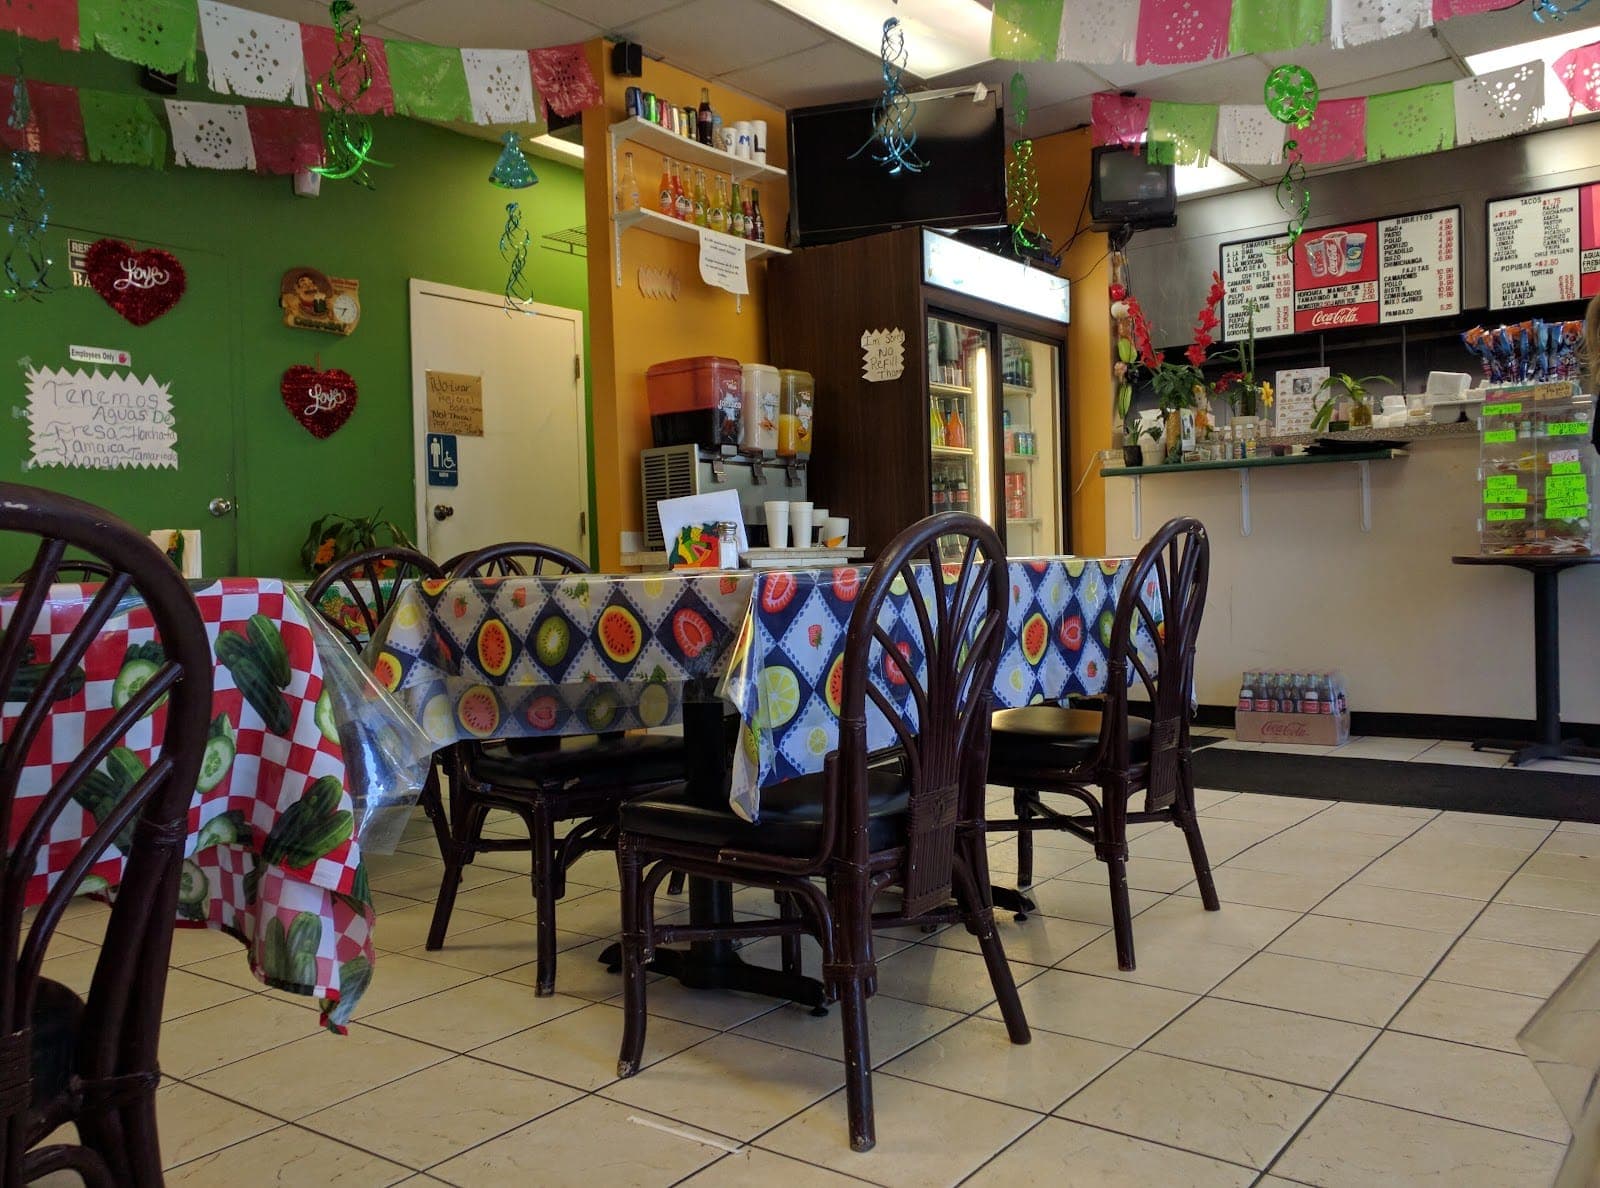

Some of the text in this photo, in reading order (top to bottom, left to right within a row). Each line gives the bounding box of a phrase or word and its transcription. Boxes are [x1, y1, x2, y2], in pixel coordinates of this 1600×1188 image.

[738, 134, 751, 147] M
[753, 133, 766, 153] L
[1396, 214, 1434, 225] BURRITOS
[113, 258, 170, 291] Love
[1384, 273, 1418, 282] CAMARONES
[1402, 265, 1430, 274] FAJITAS
[1312, 307, 1360, 327] Coca-Cola
[71, 348, 115, 363] Employees Only
[42, 380, 160, 409] Tenemos
[303, 383, 347, 417] Love
[92, 405, 146, 425] Aguas
[1260, 720, 1312, 738] Coca-Cola
